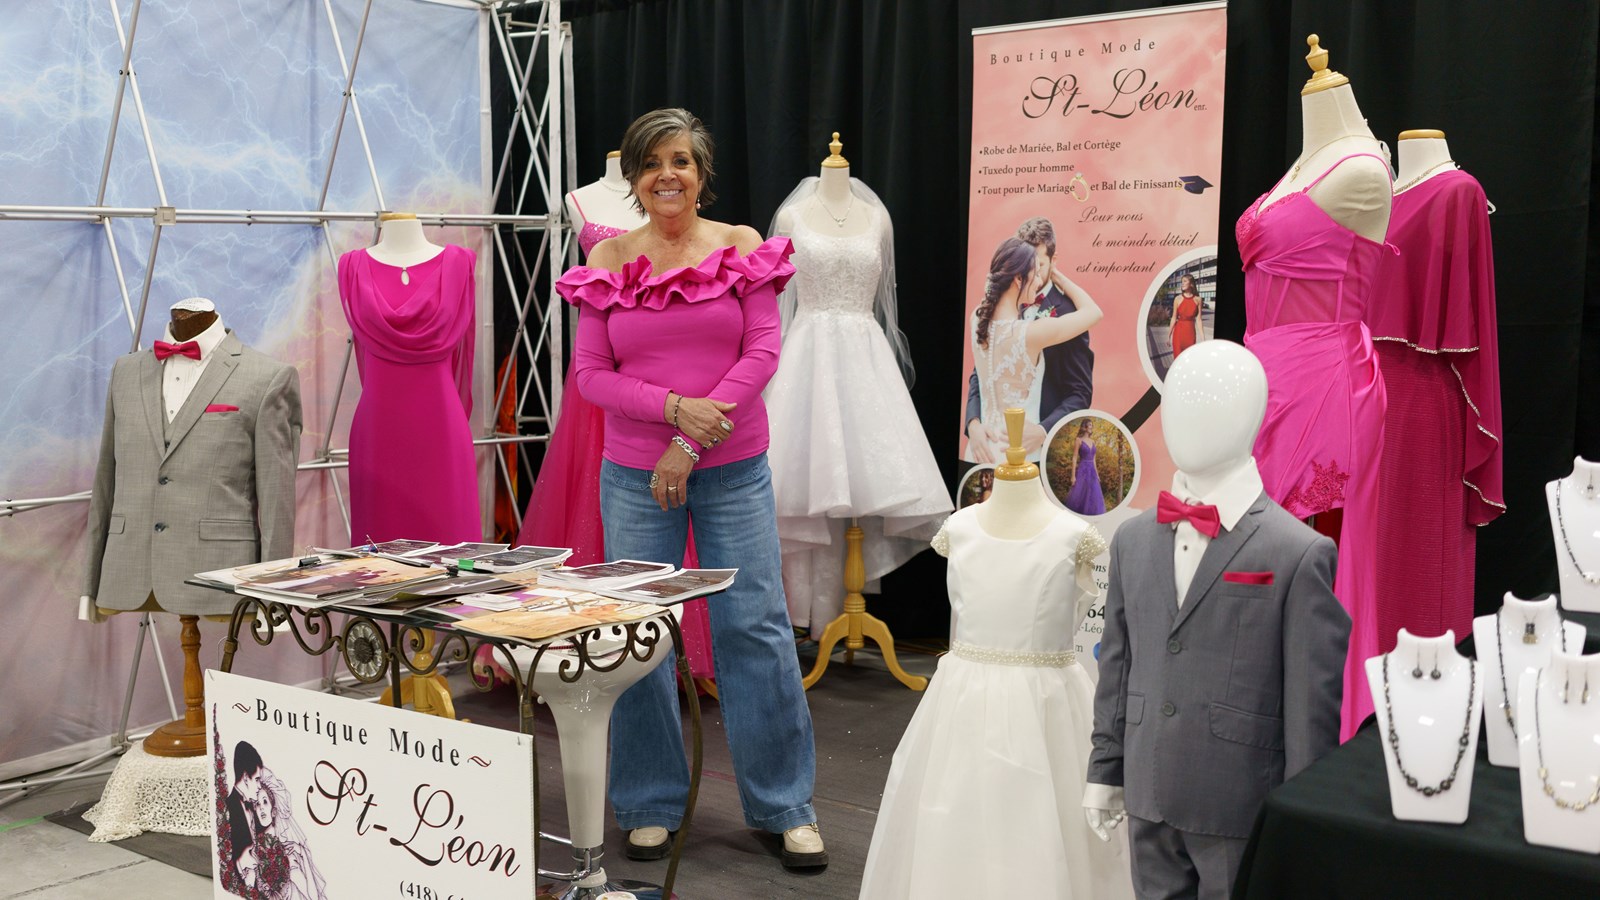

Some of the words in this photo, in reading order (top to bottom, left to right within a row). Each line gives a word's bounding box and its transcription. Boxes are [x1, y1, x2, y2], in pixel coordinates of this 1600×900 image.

[990, 47, 1085, 65] Boutique
[1101, 38, 1155, 54] Mode
[1022, 68, 1198, 119] St-Léon
[1006, 144, 1017, 154] de
[1019, 143, 1054, 153] Mariée,
[1056, 141, 1071, 152] Bal
[1073, 142, 1082, 151] et
[1084, 139, 1121, 151] Cortège
[1015, 165, 1037, 176] pour
[1039, 163, 1075, 173] homme
[1003, 186, 1024, 197] pour
[1026, 183, 1035, 194] le
[1037, 183, 1075, 193] Mariage
[1090, 182, 1099, 191] et
[1101, 180, 1117, 191] Bal
[1118, 180, 1131, 190] de
[1133, 179, 1183, 190] Finissants
[1078, 206, 1114, 223] Pour
[1116, 213, 1143, 222] nous
[1092, 233, 1103, 248] le
[1105, 232, 1157, 248] moindre
[1159, 231, 1199, 247] détail
[1076, 261, 1092, 273] est
[1093, 261, 1156, 278] important
[256, 698, 368, 746] Boutique
[389, 728, 460, 766] Mode
[306, 760, 520, 877] St-Léon
